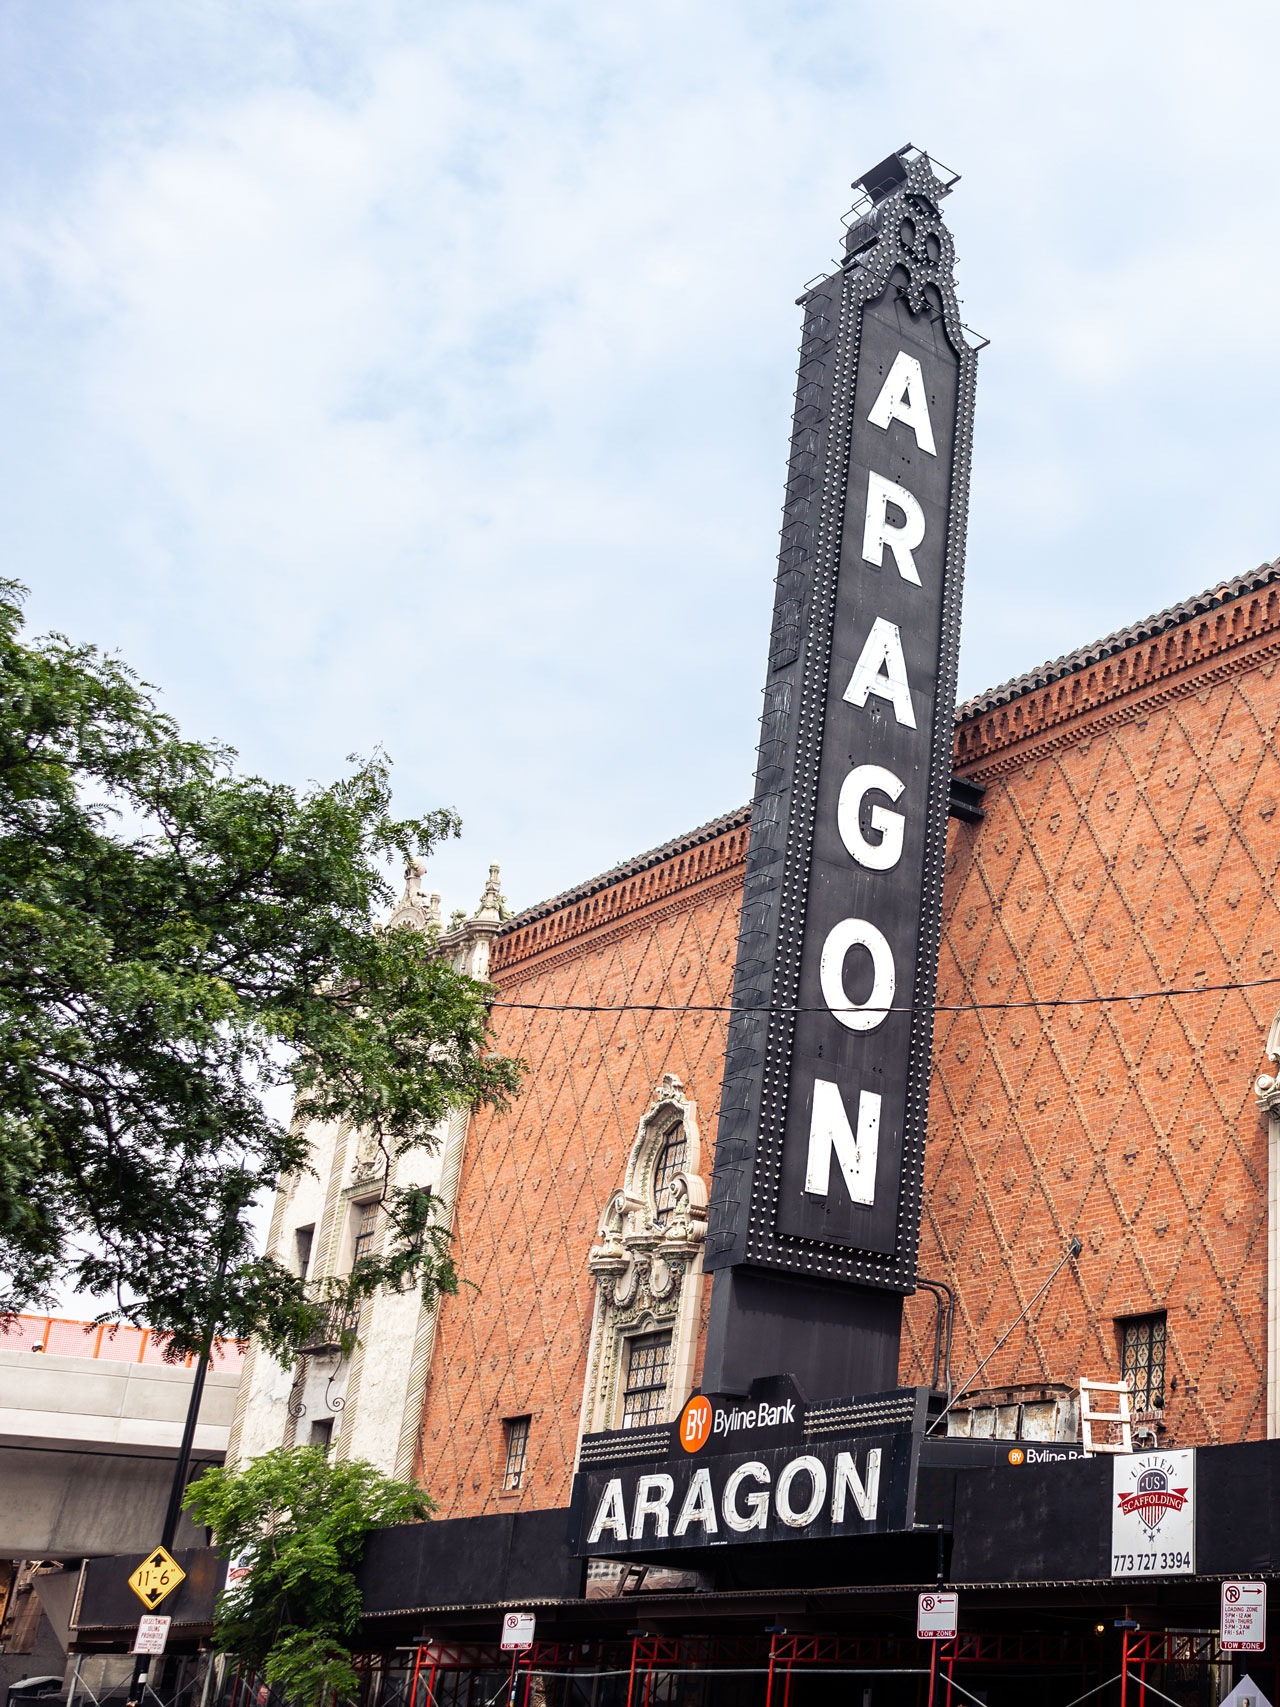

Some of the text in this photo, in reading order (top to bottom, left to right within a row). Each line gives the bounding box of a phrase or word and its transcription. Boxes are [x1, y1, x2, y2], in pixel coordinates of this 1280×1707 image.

[805, 350, 937, 1206] ARAGON
[685, 1399, 796, 1441] BY Byline Bank
[1011, 1452, 1022, 1462] BY
[1130, 1456, 1175, 1478] UNITED
[1145, 1476, 1160, 1490] US
[587, 1448, 882, 1543] ARAGON
[1123, 1494, 1182, 1513] SCAFFOLDING
[1113, 1552, 1190, 1572] 773 727 3394
